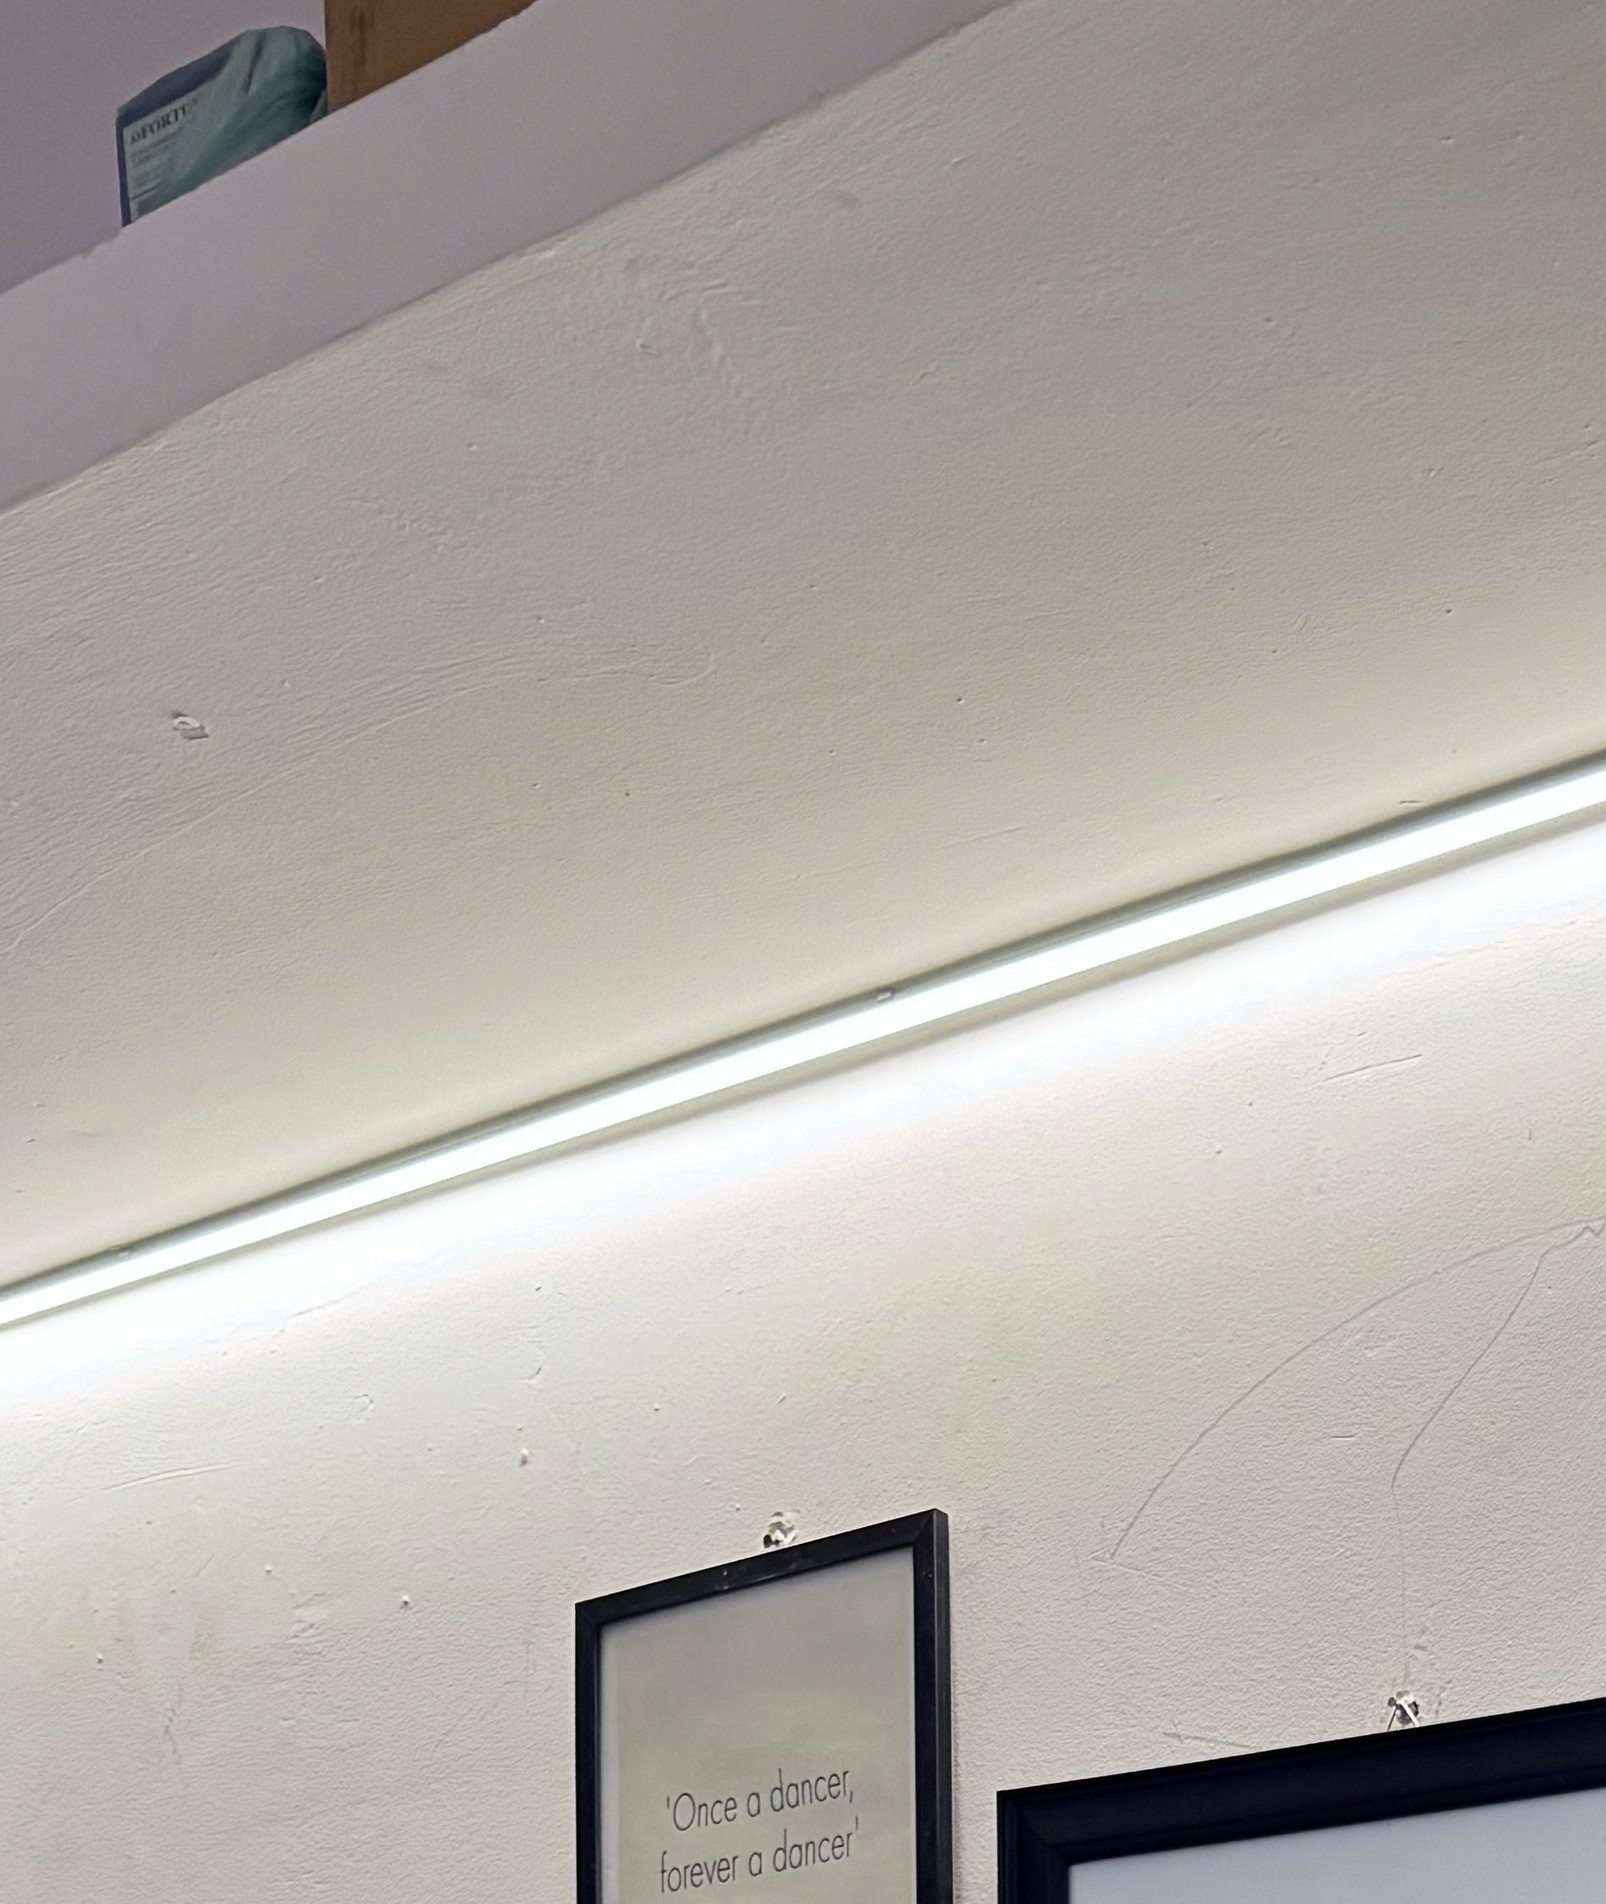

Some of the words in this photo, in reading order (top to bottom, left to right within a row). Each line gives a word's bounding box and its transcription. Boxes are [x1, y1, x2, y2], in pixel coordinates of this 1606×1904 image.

[666, 1792, 738, 1831] 'Once
[747, 1792, 761, 1818] a
[770, 1767, 854, 1803] dancer,
[661, 1850, 739, 1893] forever
[748, 1852, 763, 1877] a
